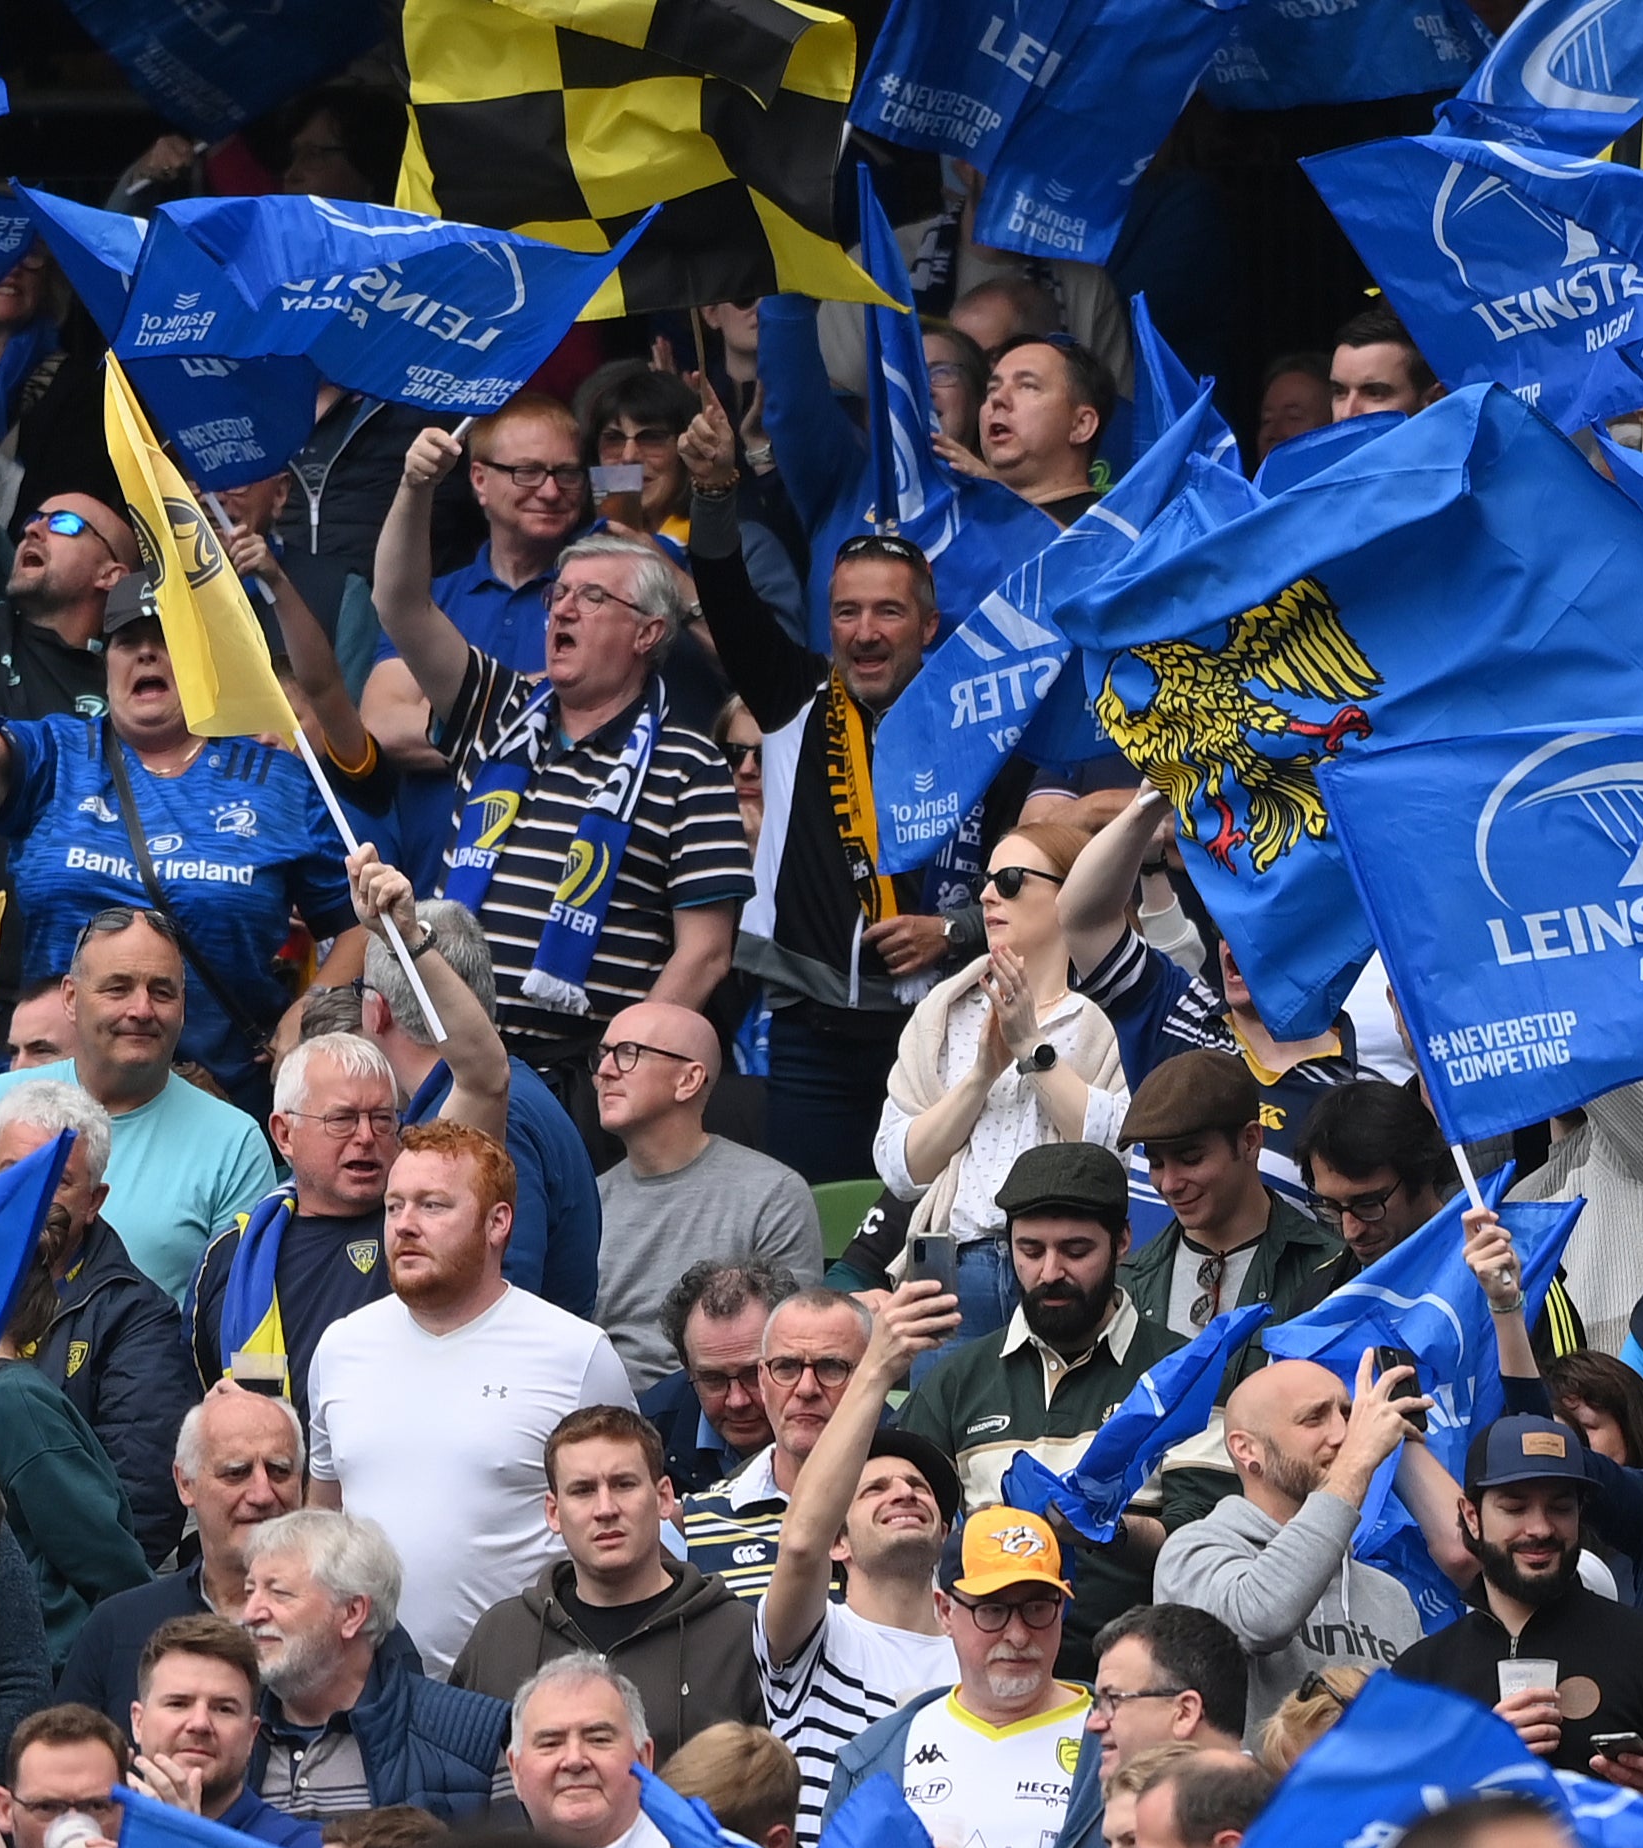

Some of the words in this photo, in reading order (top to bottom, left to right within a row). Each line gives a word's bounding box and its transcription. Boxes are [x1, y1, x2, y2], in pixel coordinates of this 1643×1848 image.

[879, 73, 1002, 131] #NEVERSTOP
[879, 100, 982, 150] COMPETING
[1584, 307, 1635, 354] RUGBY
[179, 416, 255, 451] #NEVERSTOP
[194, 441, 266, 473] COMPETING
[66, 847, 133, 881] Bank
[165, 859, 254, 886] Ireland
[1427, 1009, 1577, 1064] #NEVERSTOP
[1444, 1038, 1571, 1088] COMPETING
[926, 1784, 948, 1798] TP
